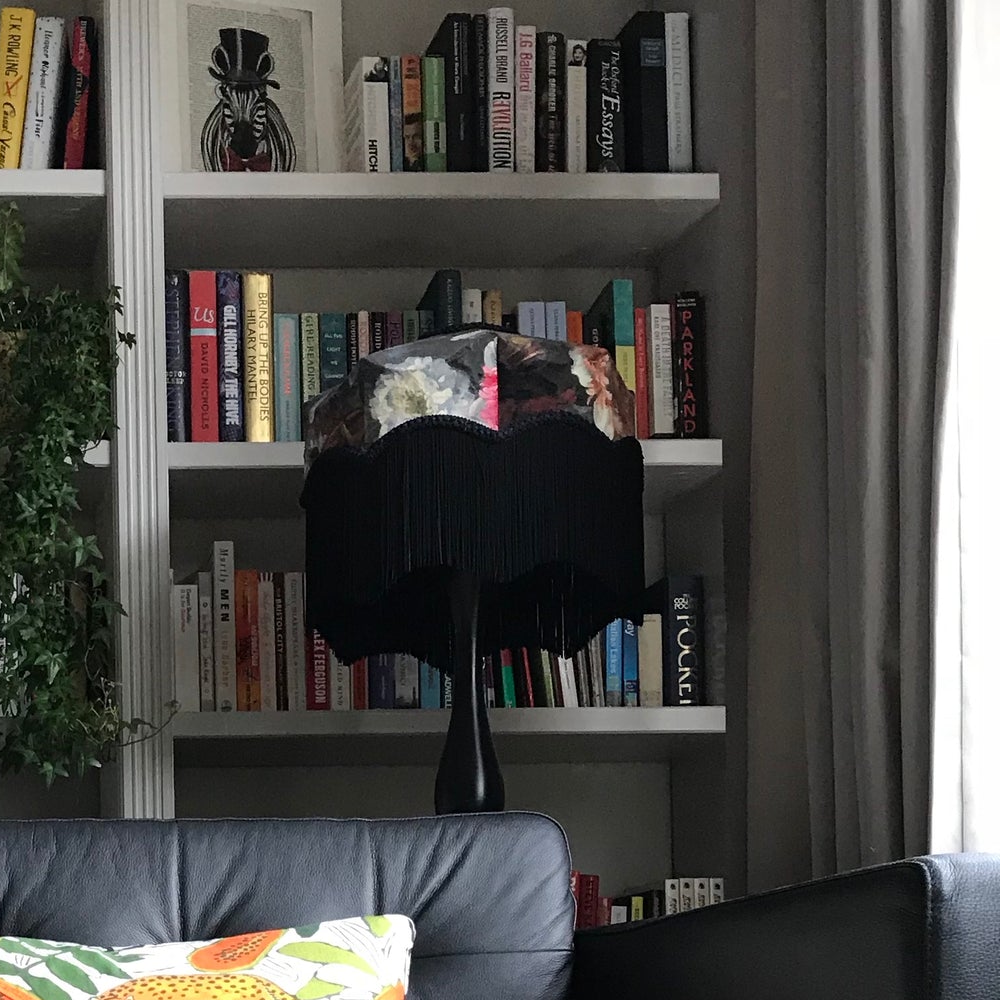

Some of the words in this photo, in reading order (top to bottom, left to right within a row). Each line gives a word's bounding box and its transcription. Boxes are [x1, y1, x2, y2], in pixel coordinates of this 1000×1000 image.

[496, 17, 509, 54] RUSSELL
[4, 34, 22, 78] ROWLING
[495, 56, 509, 84] BRAND
[519, 52, 534, 93] Ballard
[610, 66, 621, 95] Oxford
[1, 101, 17, 136] Casual
[595, 93, 622, 159] Essays
[166, 288, 180, 362] STEPHEN
[223, 304, 237, 327] GILL
[258, 292, 269, 329] BRING
[305, 315, 315, 342] GIRL
[246, 309, 257, 351] HILARY
[258, 332, 269, 349] UP
[200, 342, 209, 374] DAVID
[224, 328, 238, 374] HORNBY
[259, 353, 269, 377] THE
[306, 345, 317, 391] READING
[225, 378, 239, 399] THE
[247, 354, 258, 405] MANTEL
[682, 310, 697, 438] PARKLAND
[201, 377, 210, 431] NICHOLLS
[226, 399, 239, 426] HIVE
[259, 379, 270, 422] BODIES
[220, 588, 230, 623] MEN
[275, 597, 283, 631] BRISTOL
[276, 633, 284, 655] CITY
[609, 648, 620, 675] Lakes
[313, 653, 328, 704] FERGUSON
